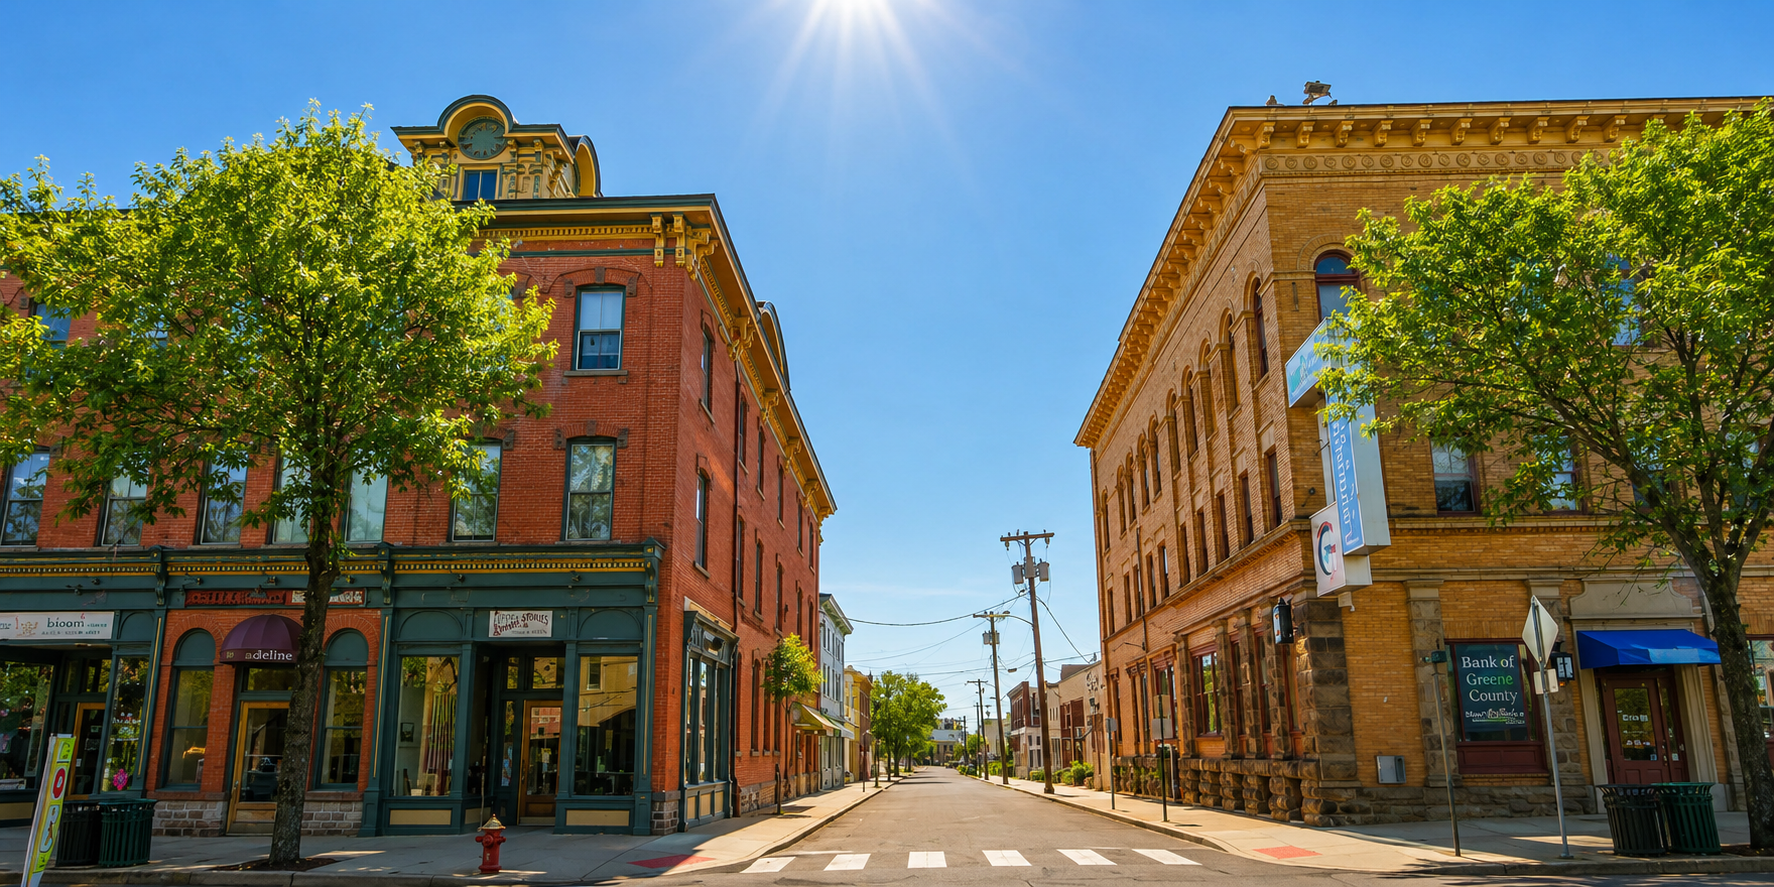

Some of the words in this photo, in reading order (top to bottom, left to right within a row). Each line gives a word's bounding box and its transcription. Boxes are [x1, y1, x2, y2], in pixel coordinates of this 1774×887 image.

[1461, 655, 1498, 668] Bank
[1500, 655, 1514, 668] of
[1466, 672, 1514, 686] Greene
[1469, 688, 1518, 705] County
